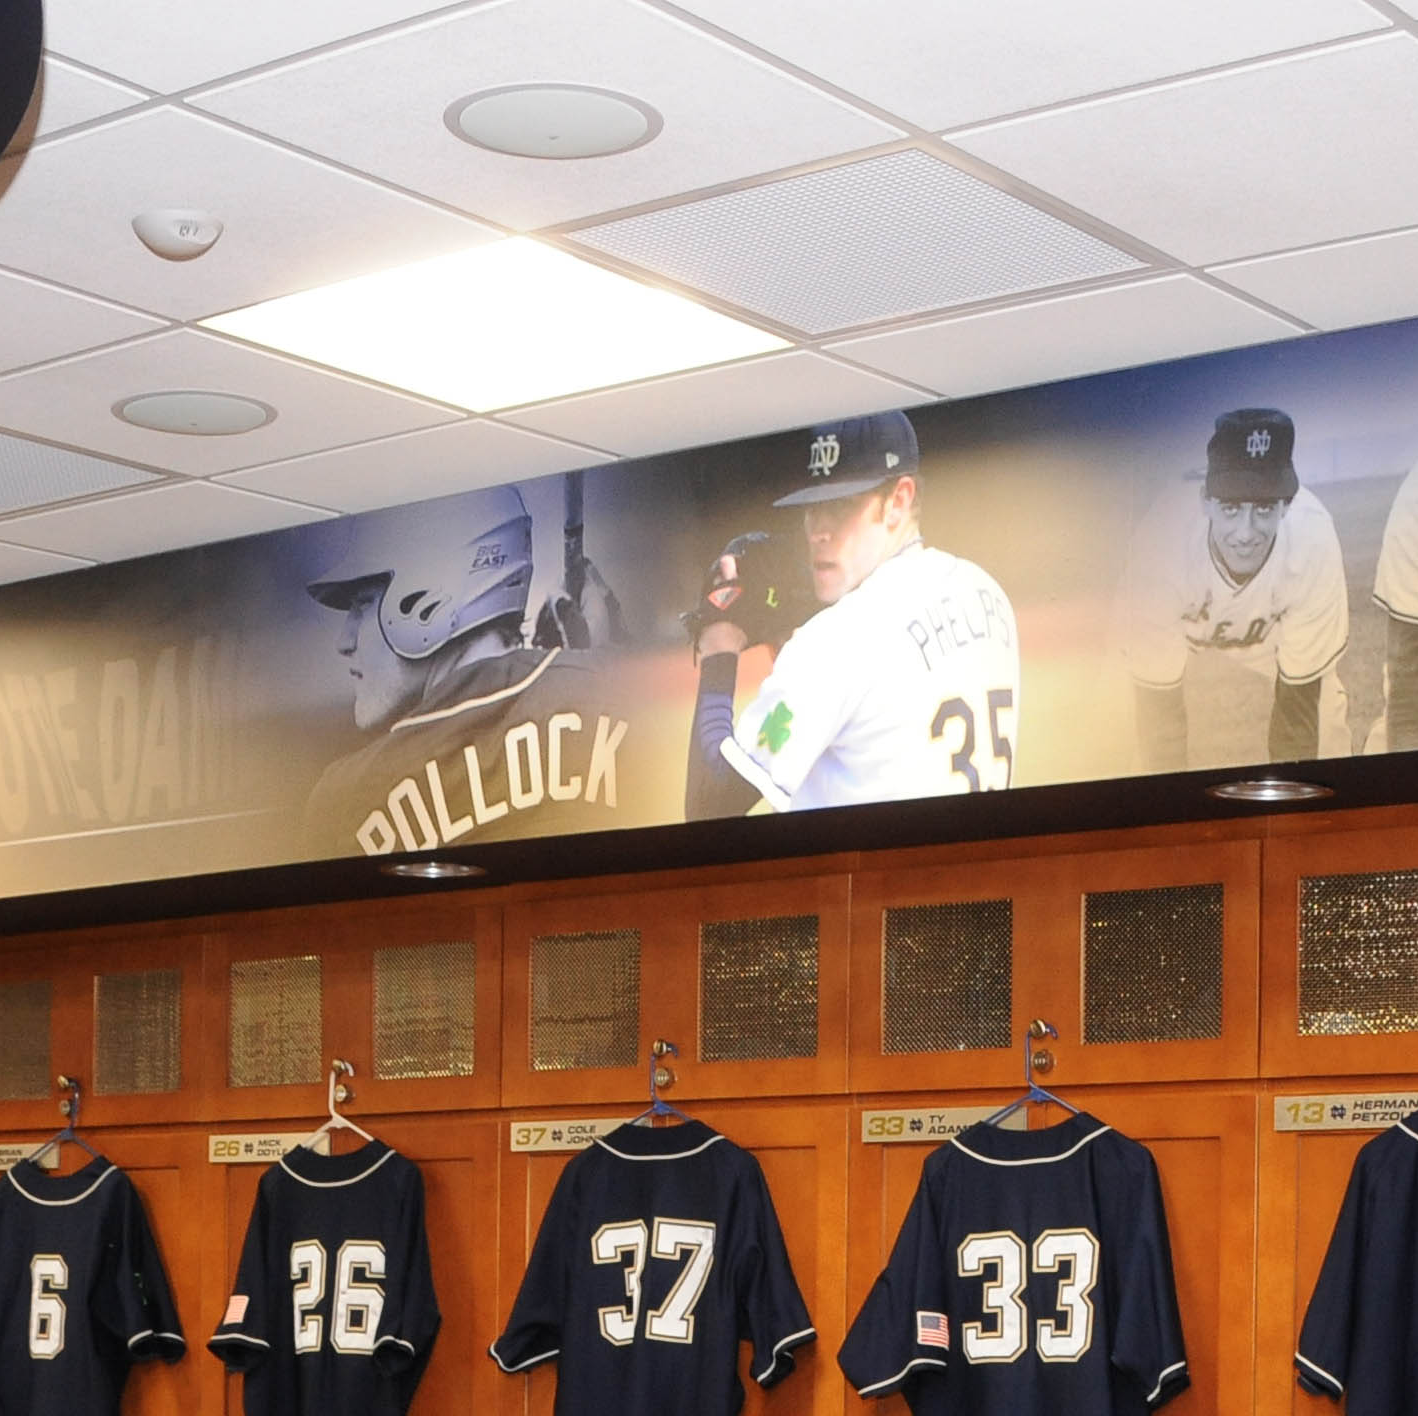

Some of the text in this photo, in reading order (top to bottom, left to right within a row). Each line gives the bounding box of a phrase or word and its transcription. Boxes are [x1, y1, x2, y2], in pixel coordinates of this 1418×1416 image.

[476, 543, 503, 558] BIG
[470, 554, 509, 570] EAST
[905, 588, 1012, 672] PHELPS
[929, 688, 1014, 793] 35
[355, 711, 630, 857] POLLOCK
[929, 1114, 945, 1123] TY
[1286, 1102, 1325, 1124] 13
[1350, 1111, 1412, 1122] PETZOL
[566, 1125, 597, 1135] COLE
[868, 1116, 904, 1136] 33
[927, 1124, 973, 1135] ADAM
[515, 1127, 547, 1146] 37
[213, 1140, 241, 1157] 26
[590, 1216, 718, 1348] 37
[289, 1239, 387, 1356] 26
[956, 1227, 1101, 1365] 33
[28, 1253, 70, 1360] 6
